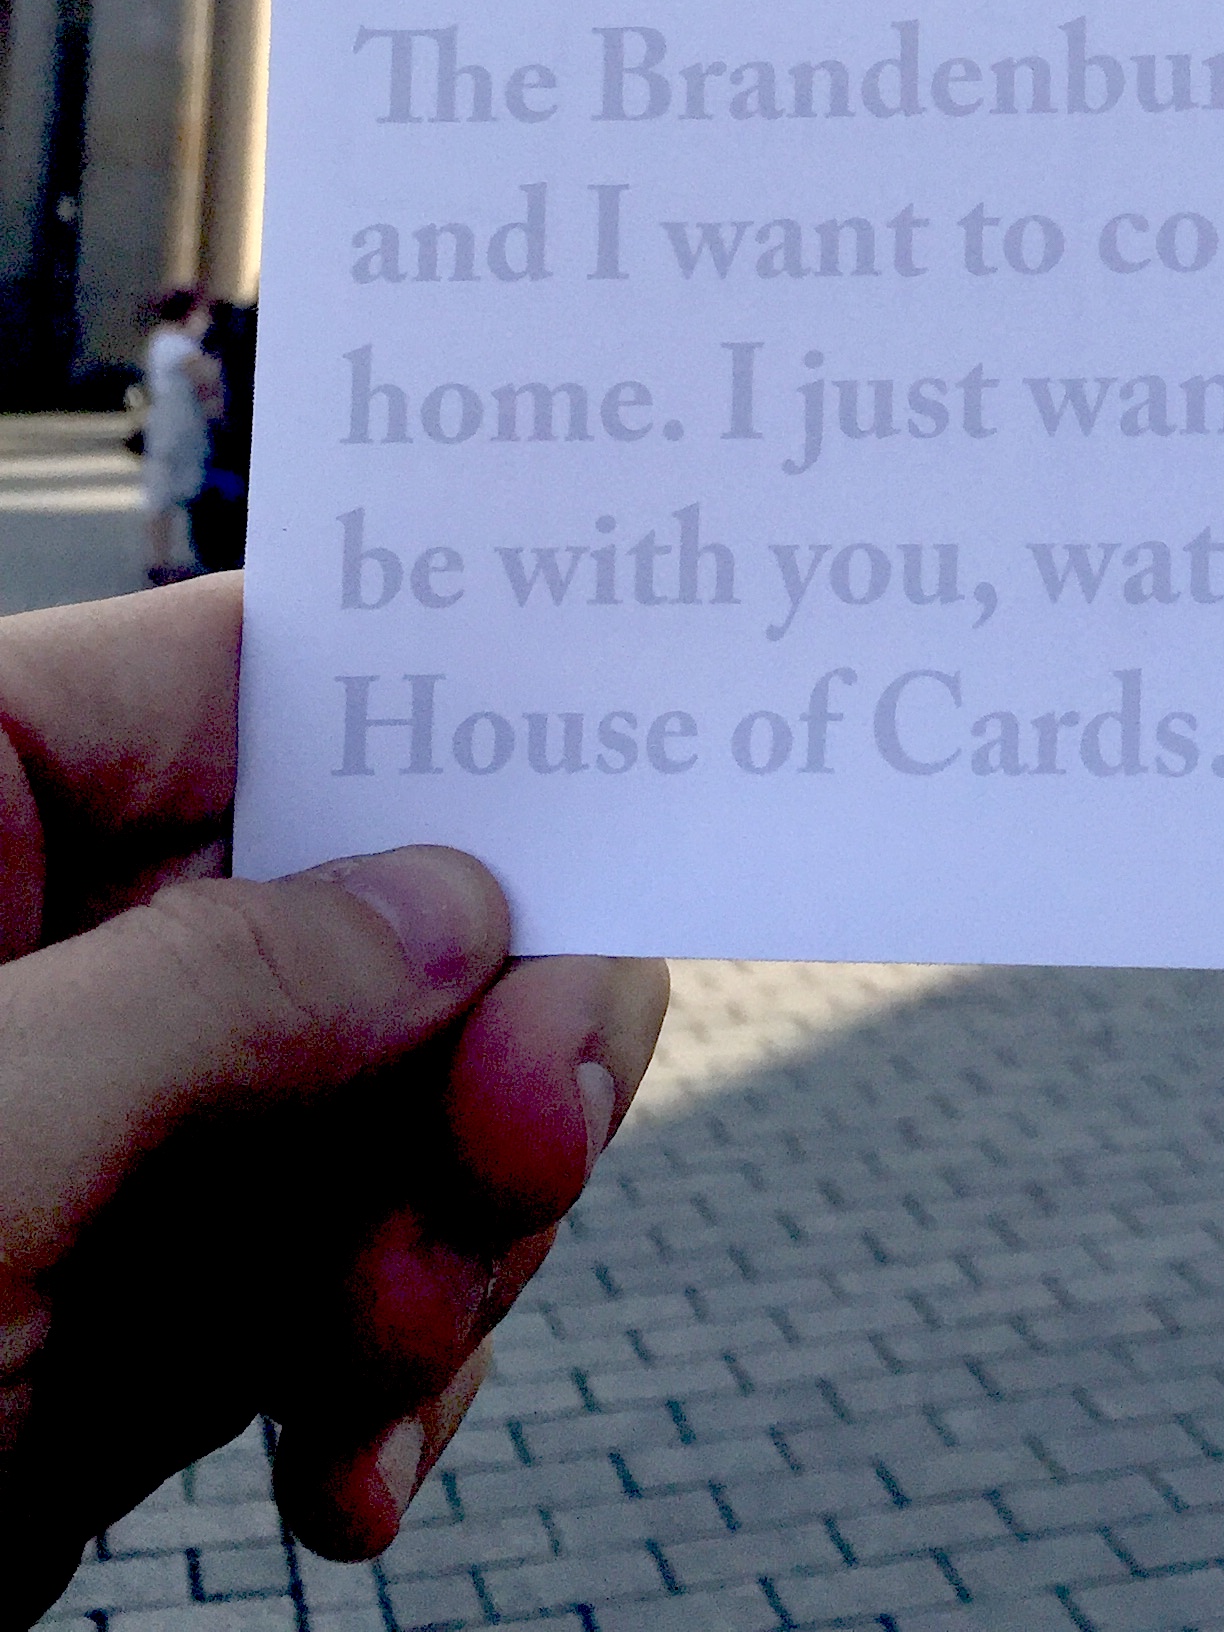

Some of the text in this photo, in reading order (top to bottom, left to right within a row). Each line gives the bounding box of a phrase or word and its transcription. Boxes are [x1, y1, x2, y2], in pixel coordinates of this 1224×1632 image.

[354, 25, 557, 123] The
[351, 182, 553, 284] and
[587, 184, 629, 280] I
[660, 204, 929, 279] want
[957, 203, 1064, 276] to
[340, 345, 684, 444] home.
[721, 342, 764, 439] I
[782, 351, 999, 475] just
[336, 507, 464, 609] be
[494, 503, 741, 607] with
[767, 543, 997, 641] you,
[331, 675, 697, 776] House
[732, 668, 857, 775] of
